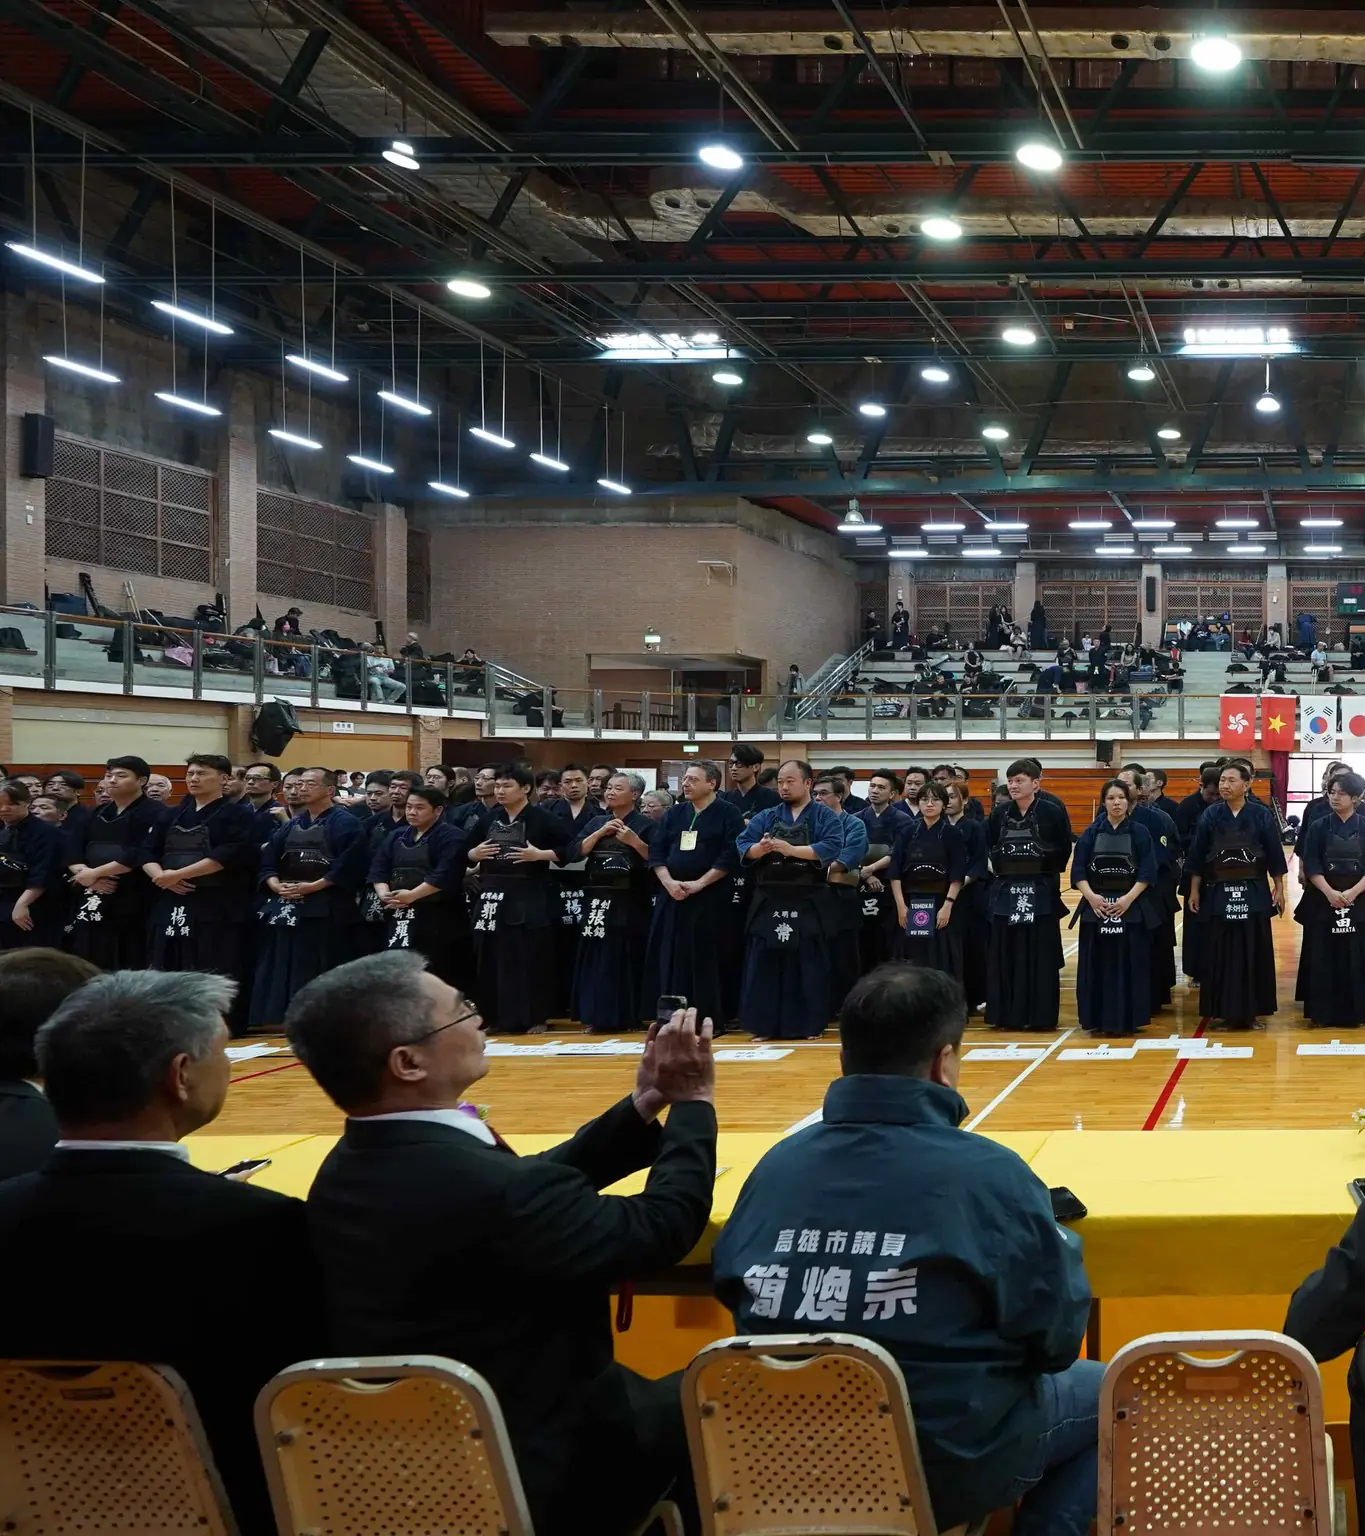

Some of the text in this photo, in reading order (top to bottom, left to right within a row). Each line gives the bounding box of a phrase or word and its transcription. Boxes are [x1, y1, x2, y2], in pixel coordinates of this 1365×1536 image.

[480, 900, 498, 920] 郭
[861, 898, 880, 916] 呂
[1016, 895, 1034, 913] 蔡
[170, 905, 187, 926] 楊
[587, 909, 606, 926] 張
[1334, 907, 1352, 927] 中田
[1100, 926, 1123, 934] PHAM
[774, 1229, 907, 1257] 高雄市議員
[743, 1264, 918, 1322] 簡煥宗
